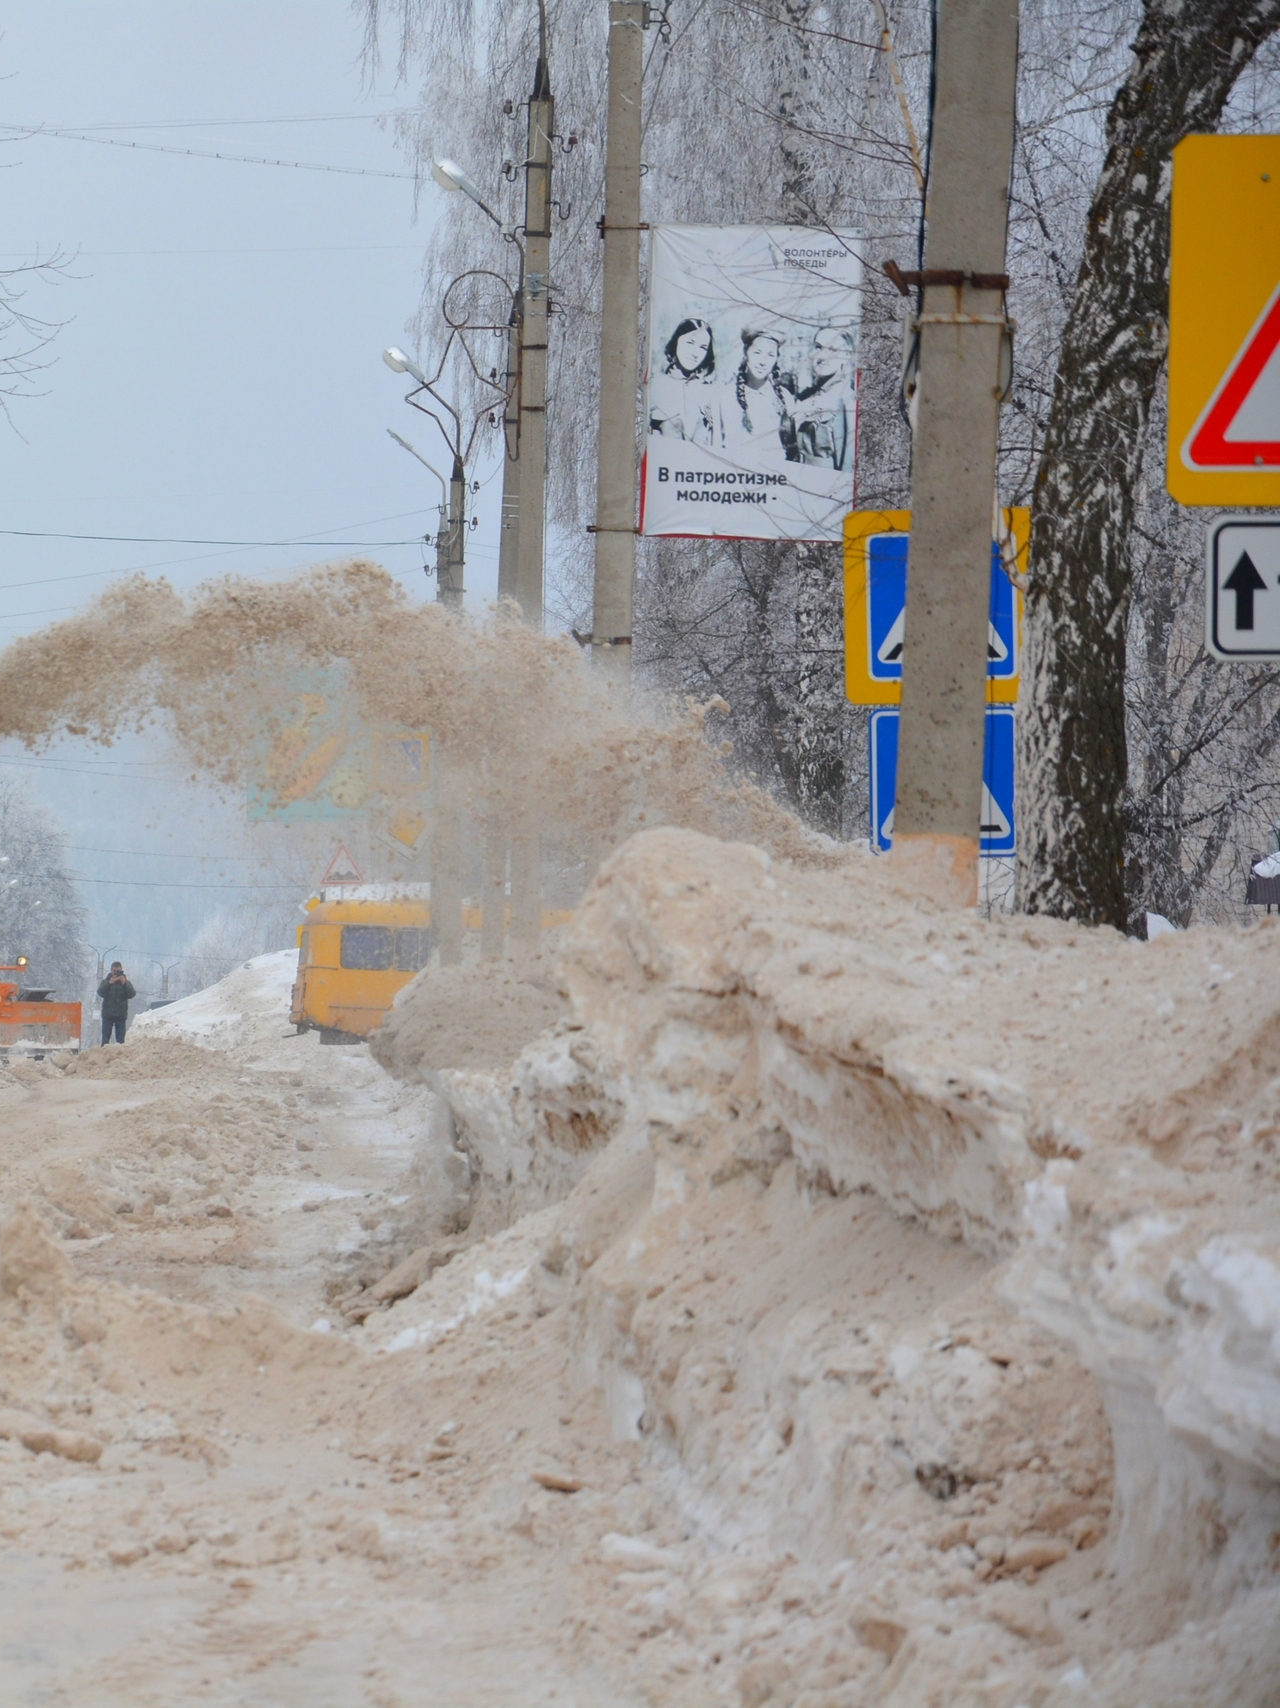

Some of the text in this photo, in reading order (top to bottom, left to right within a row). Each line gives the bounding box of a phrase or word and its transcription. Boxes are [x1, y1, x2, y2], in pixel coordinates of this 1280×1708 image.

[784, 248, 848, 258] ВОЛОНТЁРЫ
[784, 259, 827, 268] ПОБЕДЫ
[658, 467, 787, 485] В патриотизме
[677, 490, 767, 504] молодежи
